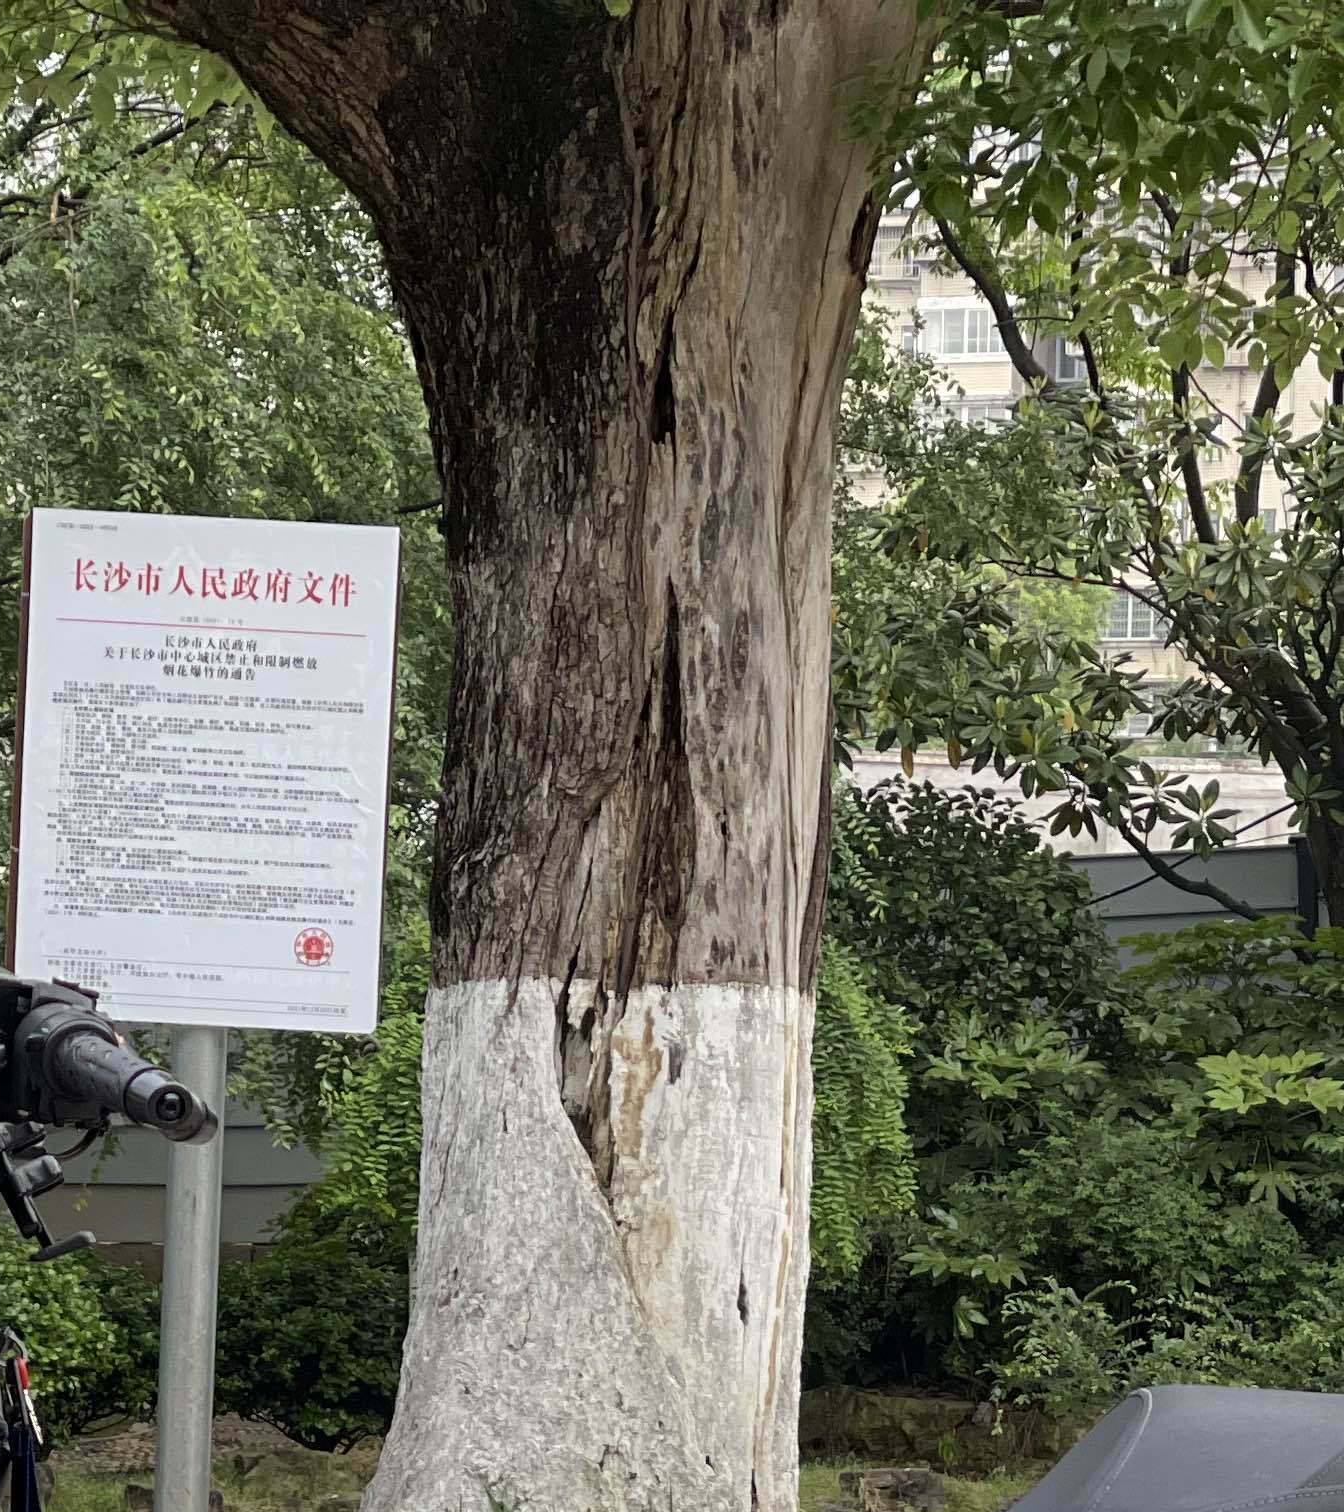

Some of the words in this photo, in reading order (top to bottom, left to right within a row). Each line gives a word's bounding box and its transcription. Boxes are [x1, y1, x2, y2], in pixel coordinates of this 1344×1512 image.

[71, 558, 358, 608] 长沙市人民政府文件
[164, 634, 258, 652] 长沙市人民政府
[103, 645, 319, 670] 关于长沙市中心城区禁止和限制燃放
[162, 663, 256, 681] 烟花爆竹的通告
